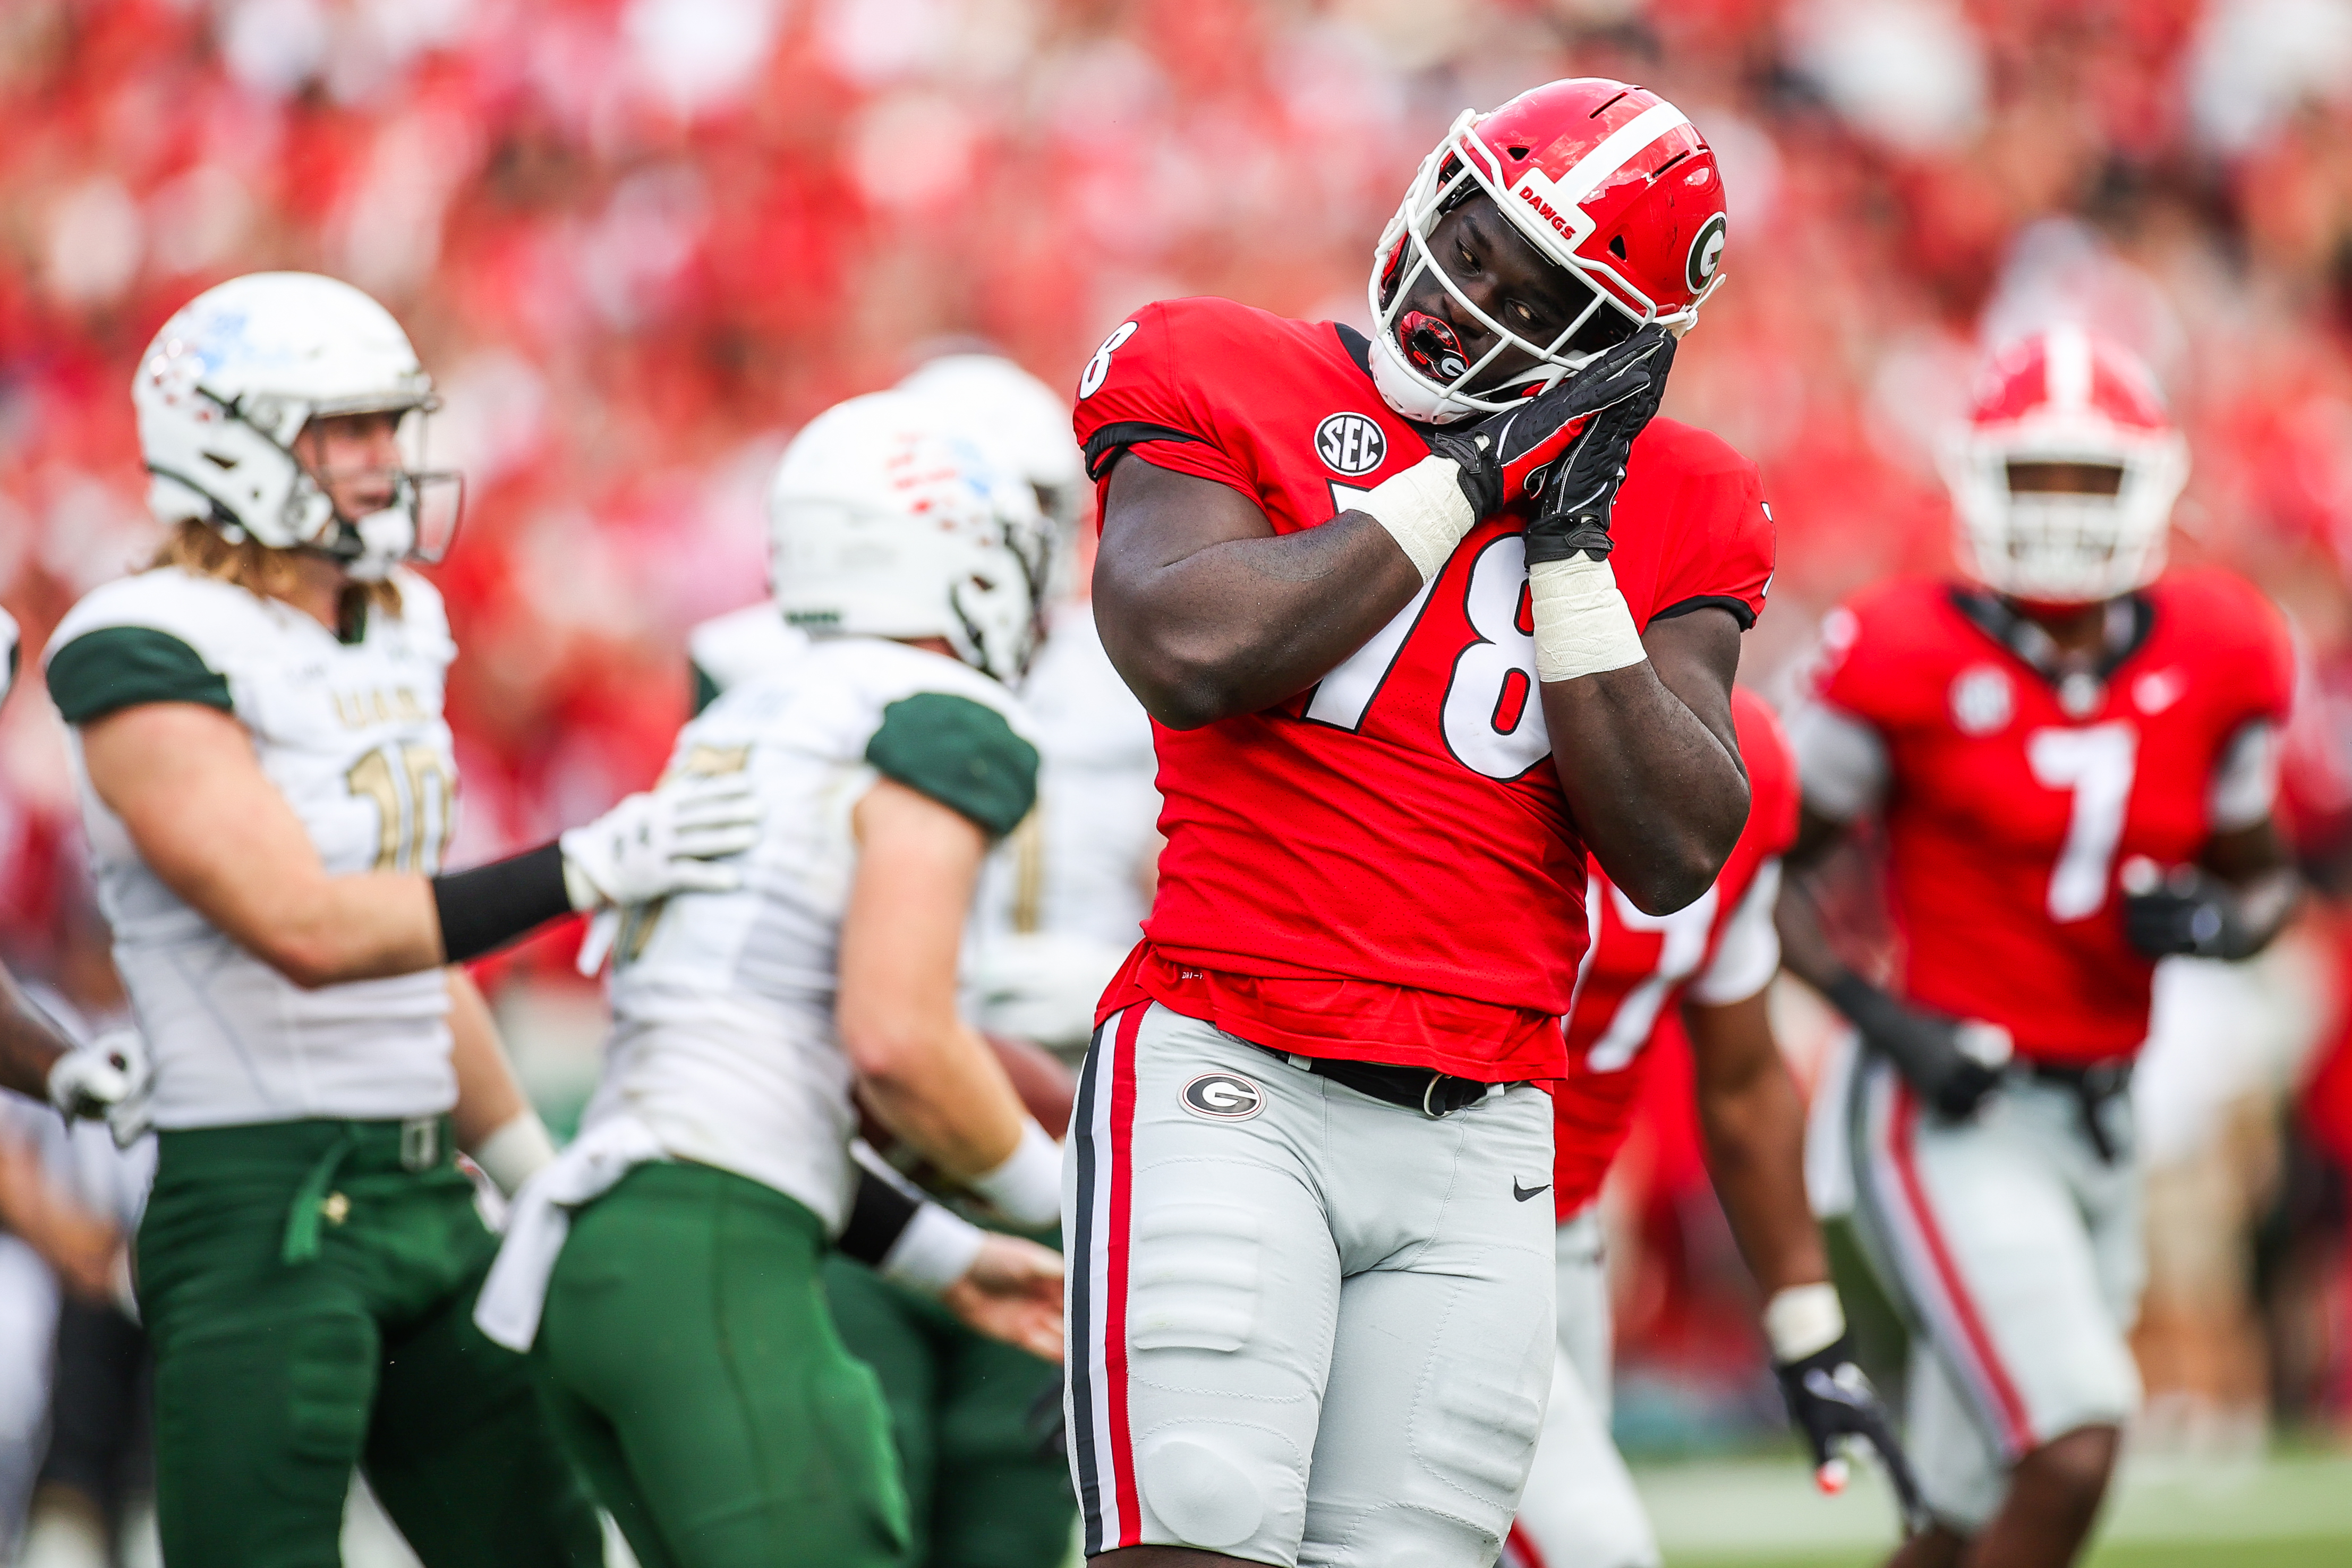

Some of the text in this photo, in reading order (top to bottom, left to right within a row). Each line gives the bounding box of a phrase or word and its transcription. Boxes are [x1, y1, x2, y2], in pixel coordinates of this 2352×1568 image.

[1519, 185, 1576, 240] DAWGS
[1079, 320, 1139, 402] 8
[1322, 416, 1380, 471] SEC
[2025, 718, 2141, 923] 7
[1184, 1075, 1259, 1115] G
